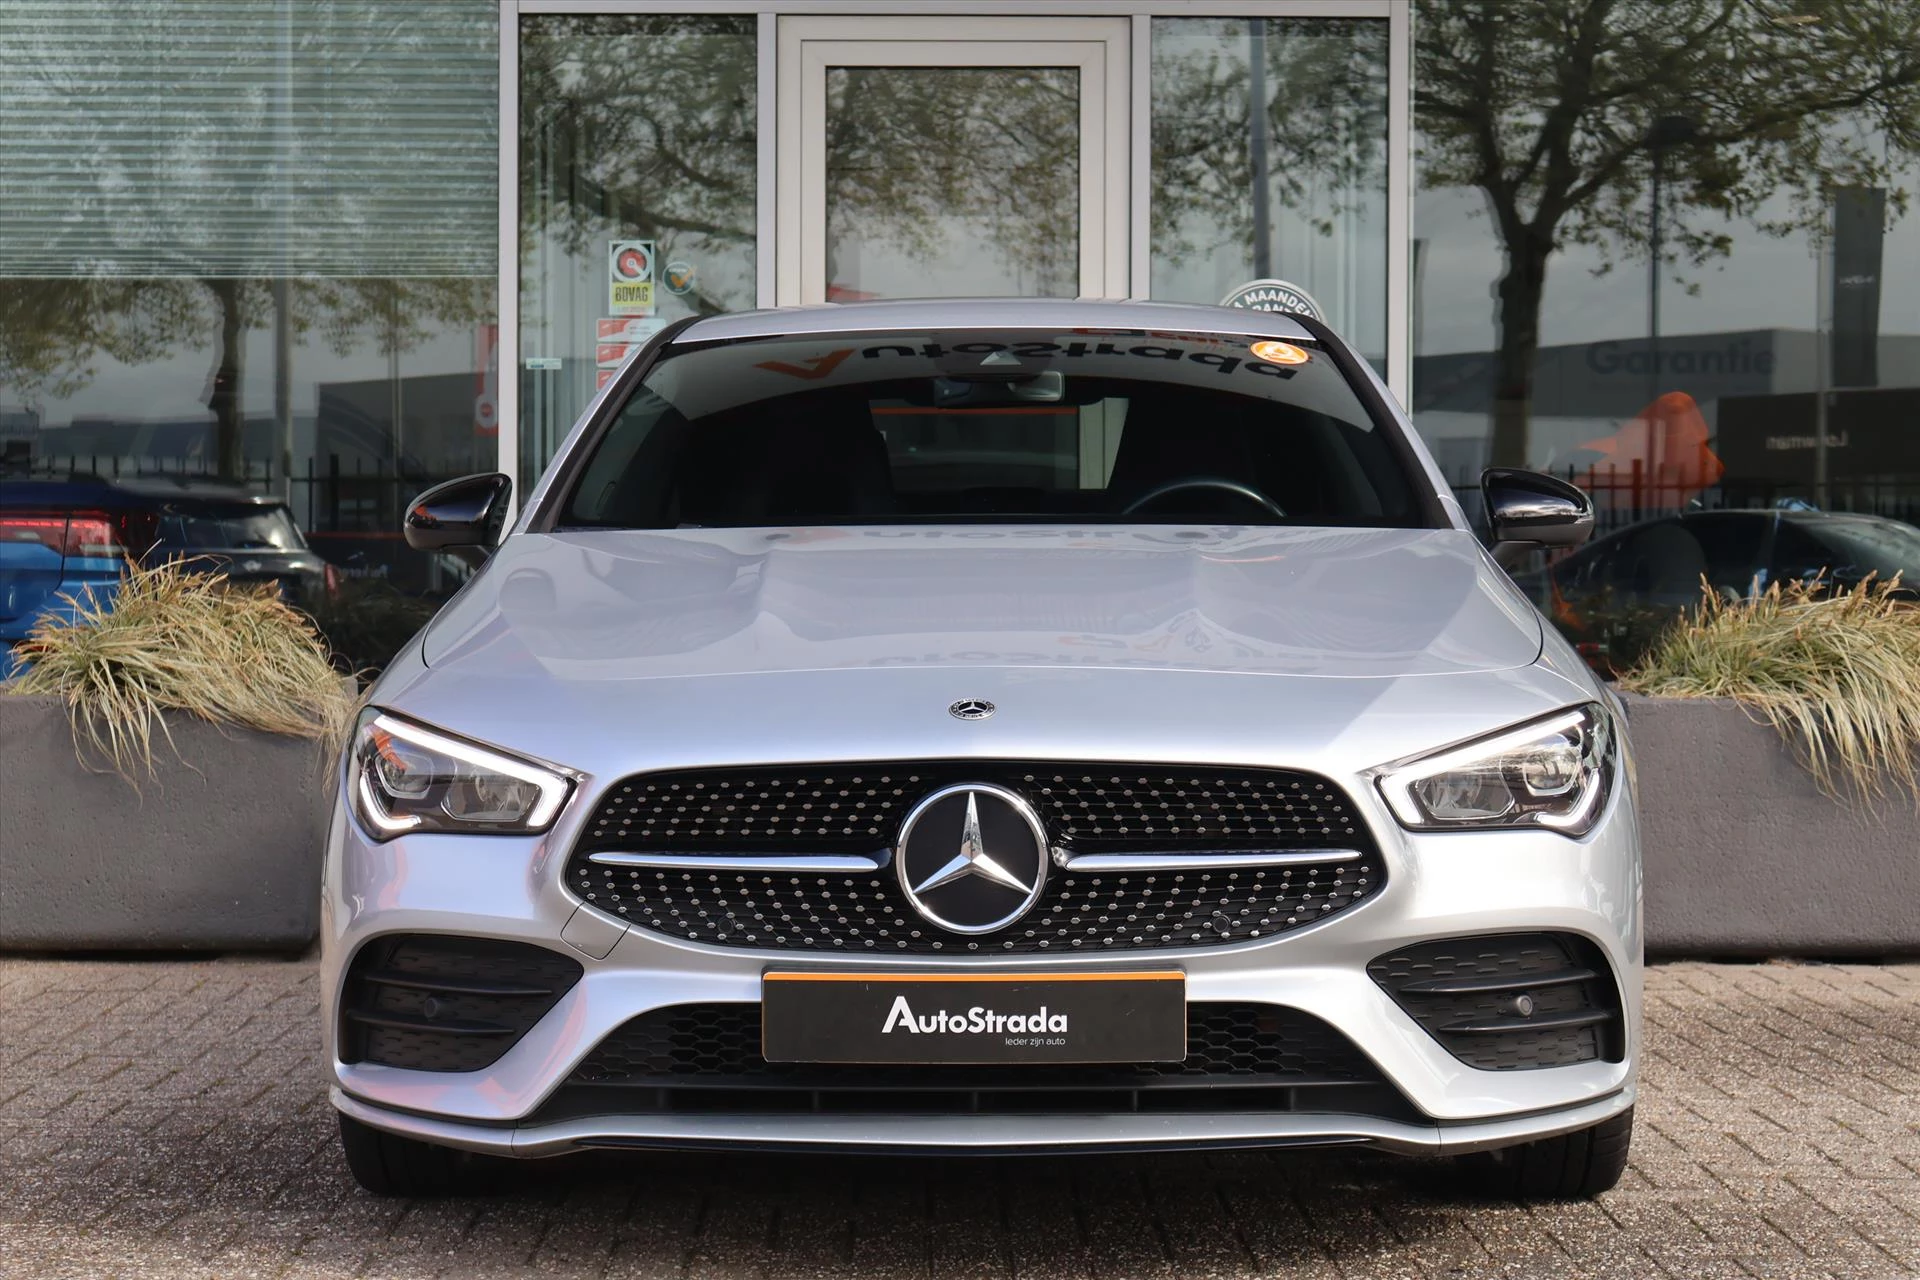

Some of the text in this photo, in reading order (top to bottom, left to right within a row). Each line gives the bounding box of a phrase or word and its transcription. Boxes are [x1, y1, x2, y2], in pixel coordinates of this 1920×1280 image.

[615, 286, 649, 302] BOVAG
[1586, 338, 1775, 376] Garantie
[881, 995, 1068, 1034] AutoStrada
[1005, 1037, 1066, 1047] Ieder zijn auto
